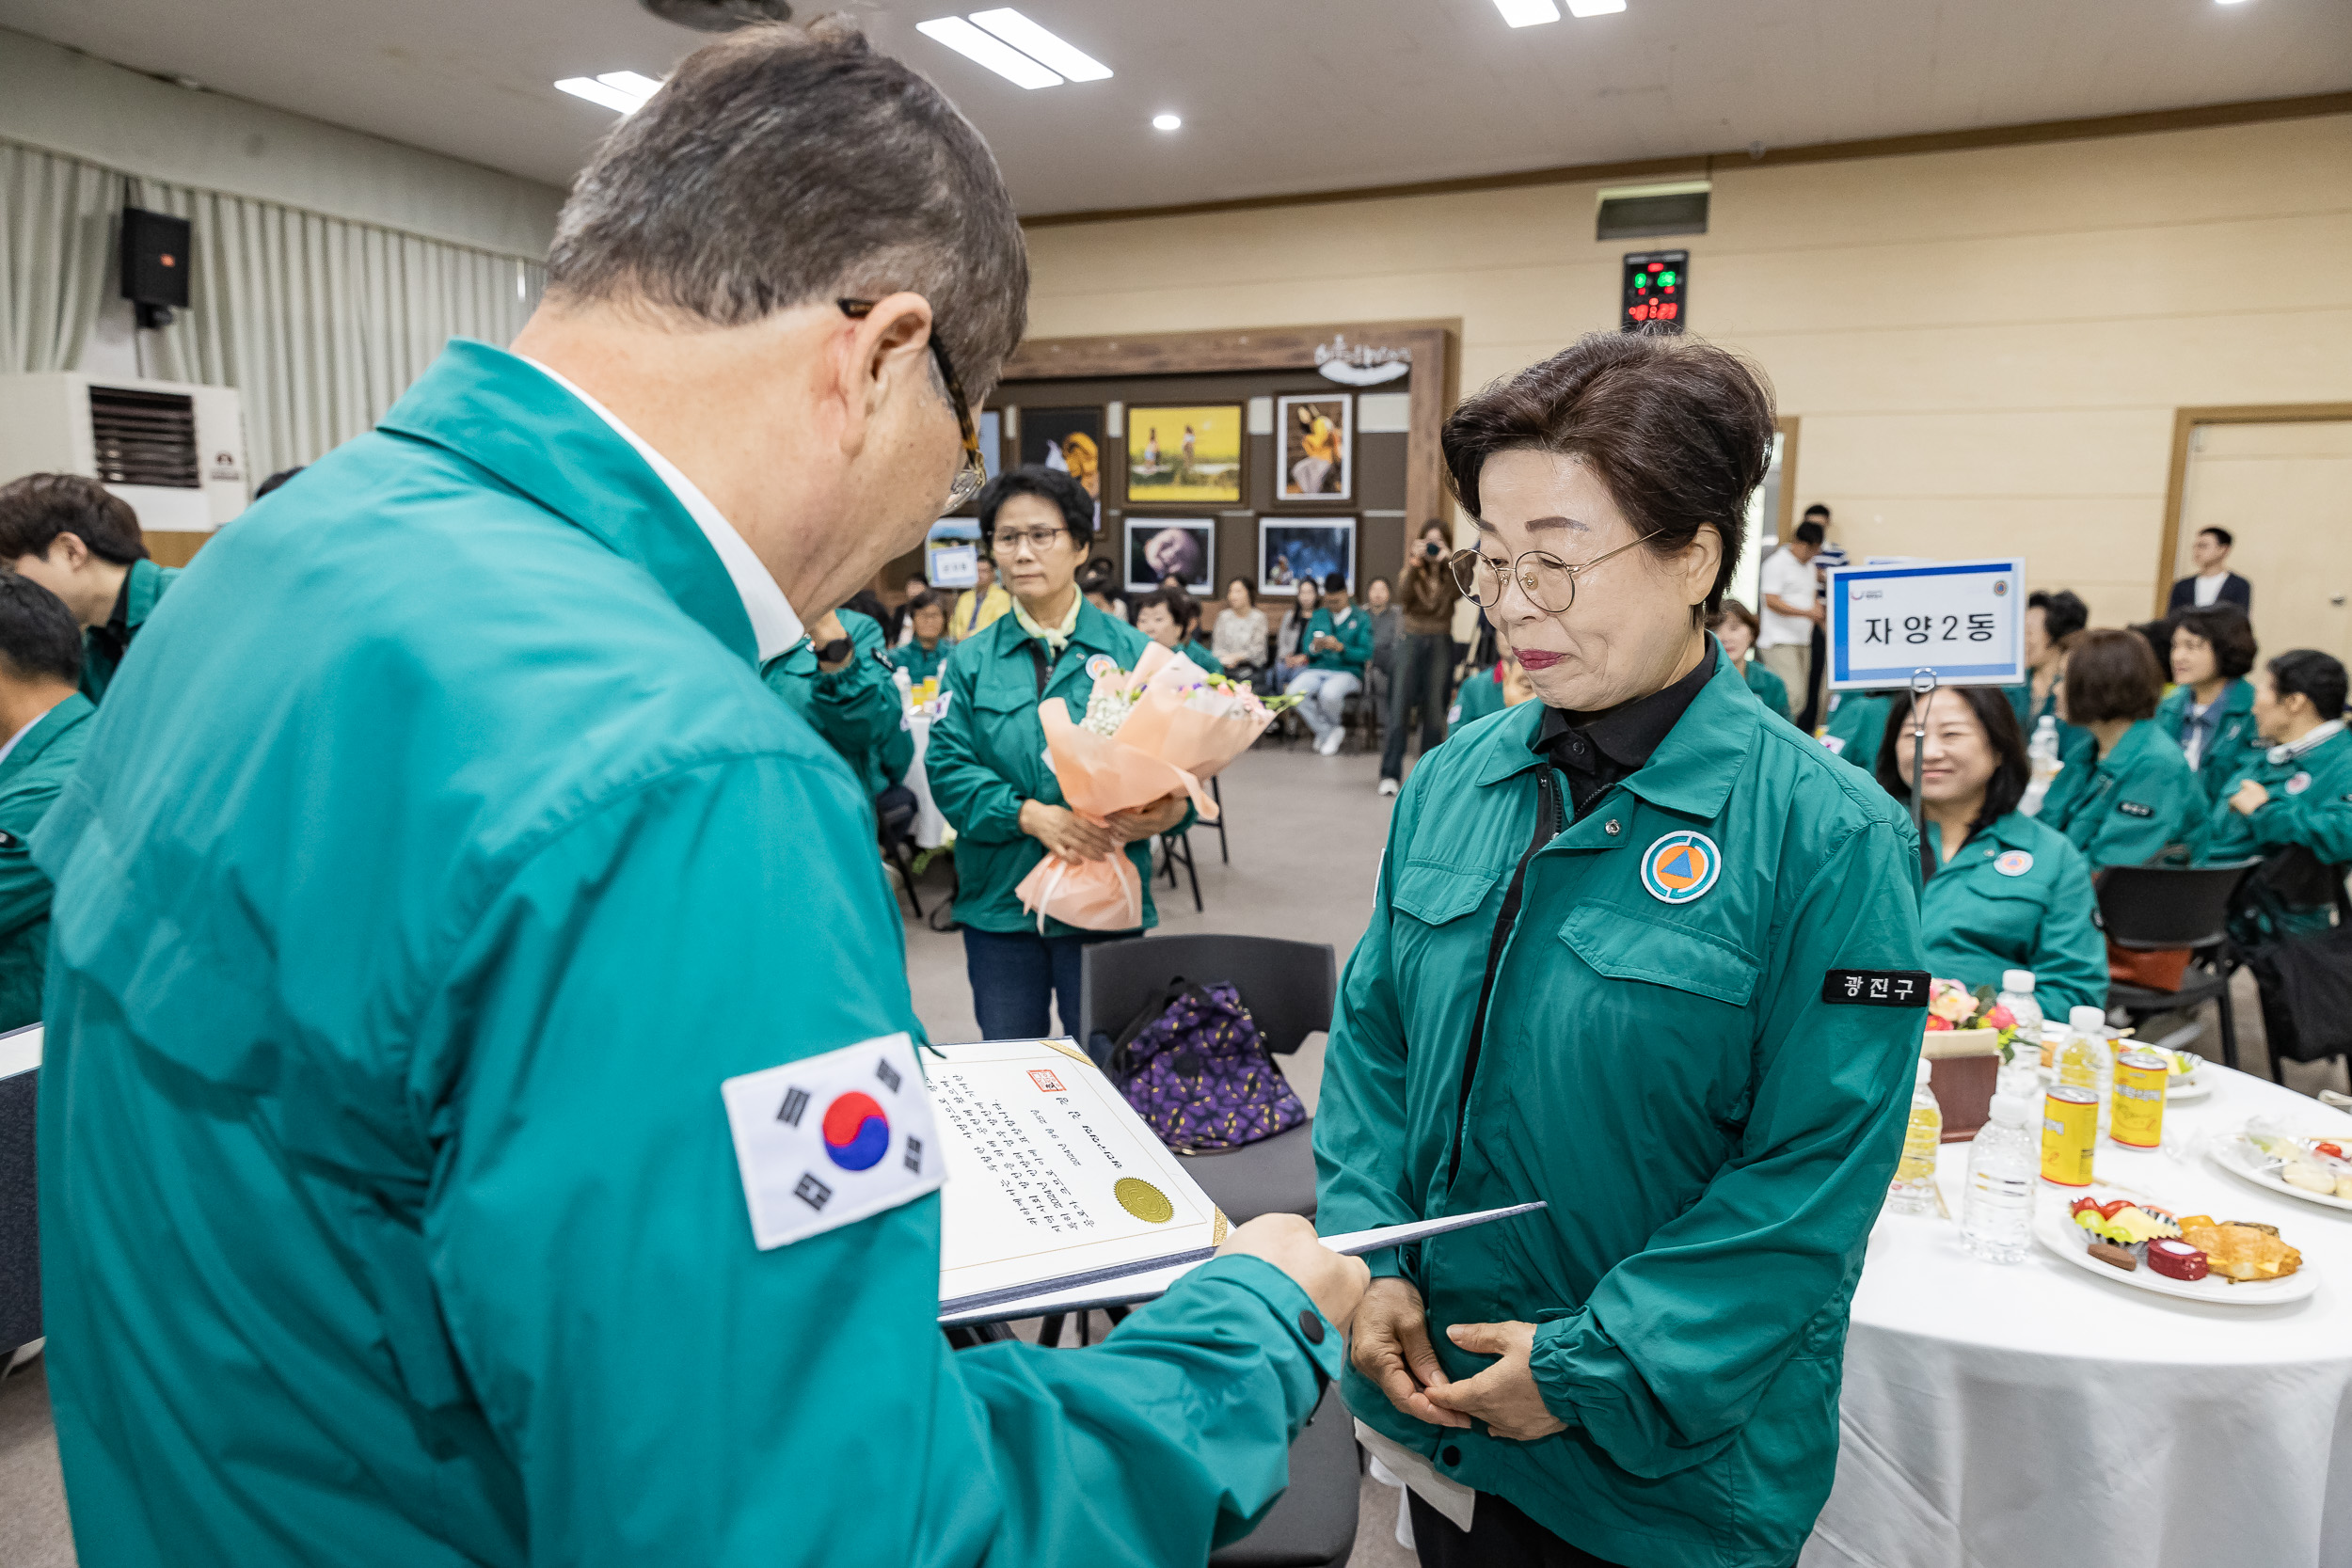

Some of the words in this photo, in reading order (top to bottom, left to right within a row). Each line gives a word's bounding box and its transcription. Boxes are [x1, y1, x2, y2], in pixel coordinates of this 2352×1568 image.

[1865, 613, 1994, 644] 자양2동
[1845, 975, 1914, 1001] 광진구
[952, 1075, 974, 1097] 기여한
[938, 1098, 971, 1138] 사명감으로
[962, 1109, 987, 1134] 공헌해
[974, 1101, 997, 1126] 발전에
[992, 1099, 1029, 1143] 표창합니다.
[1067, 1111, 1081, 1119] 김
[995, 1130, 1014, 1147] 업무
[1044, 1128, 1058, 1138] 9월
[986, 1140, 1003, 1157] 위해
[1027, 1148, 1043, 1164] 이에
[1057, 1143, 1081, 1165] 2024년
[1081, 1125, 1121, 1168] 광진구청장
[1003, 1162, 1029, 1189] 발전을
[1012, 1151, 1037, 1176] 민방위
[1036, 1181, 1063, 1208] 2024년
[1045, 1169, 1071, 1195] 크므로
[1000, 1179, 1037, 1225] 귀하께서는
[1028, 1195, 1060, 1232] 지역사회
[1069, 1200, 1094, 1227] 공로가
[1059, 1212, 1077, 1229] 특히
